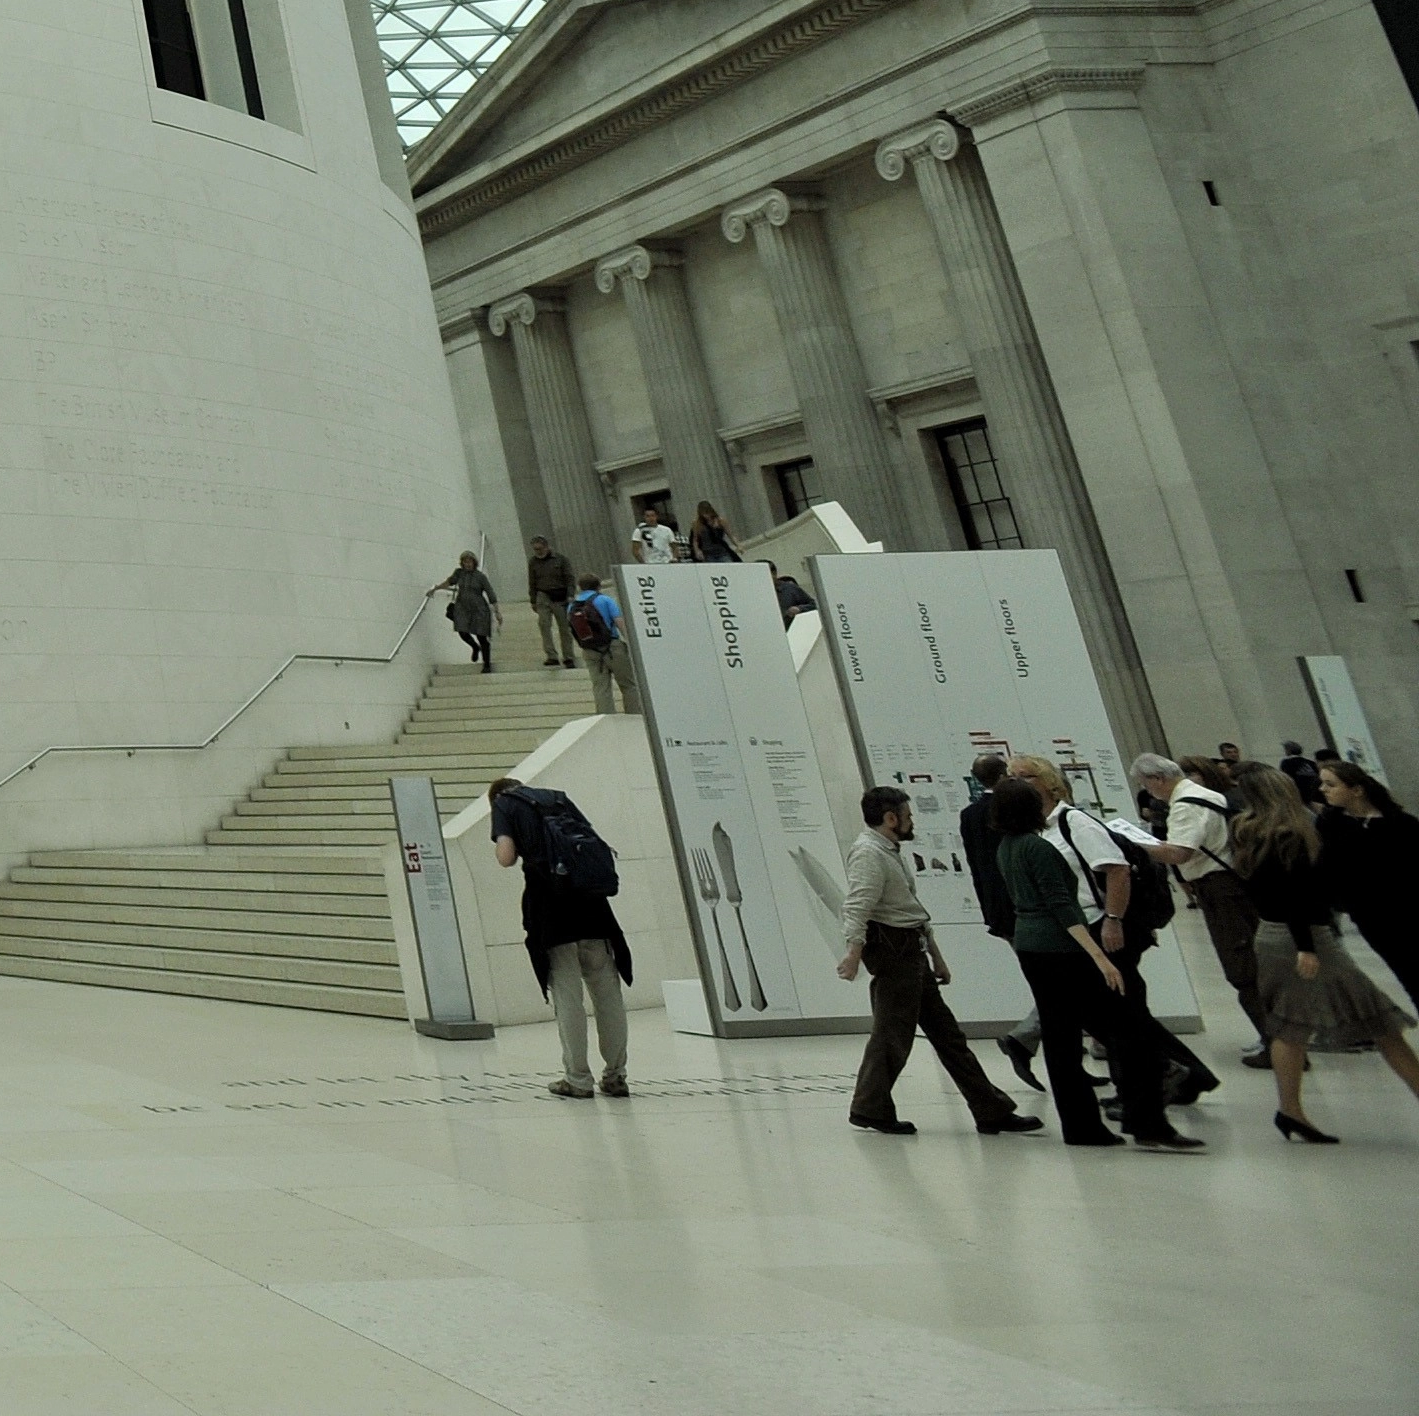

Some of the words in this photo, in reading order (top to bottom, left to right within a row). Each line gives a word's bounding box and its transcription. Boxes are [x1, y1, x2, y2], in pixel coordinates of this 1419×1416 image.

[636, 575, 663, 638] Eating
[710, 575, 744, 669] Shopping
[836, 602, 853, 640] floors
[916, 601, 933, 633] floor
[998, 598, 1017, 636] floors
[846, 643, 865, 683] Lower
[923, 635, 947, 684] Ground
[1010, 638, 1029, 678] Upper
[404, 842, 422, 873] Eat
[221, 1078, 308, 1088] and
[482, 1071, 565, 1079] fee
[596, 1085, 855, 1099] nowledge
